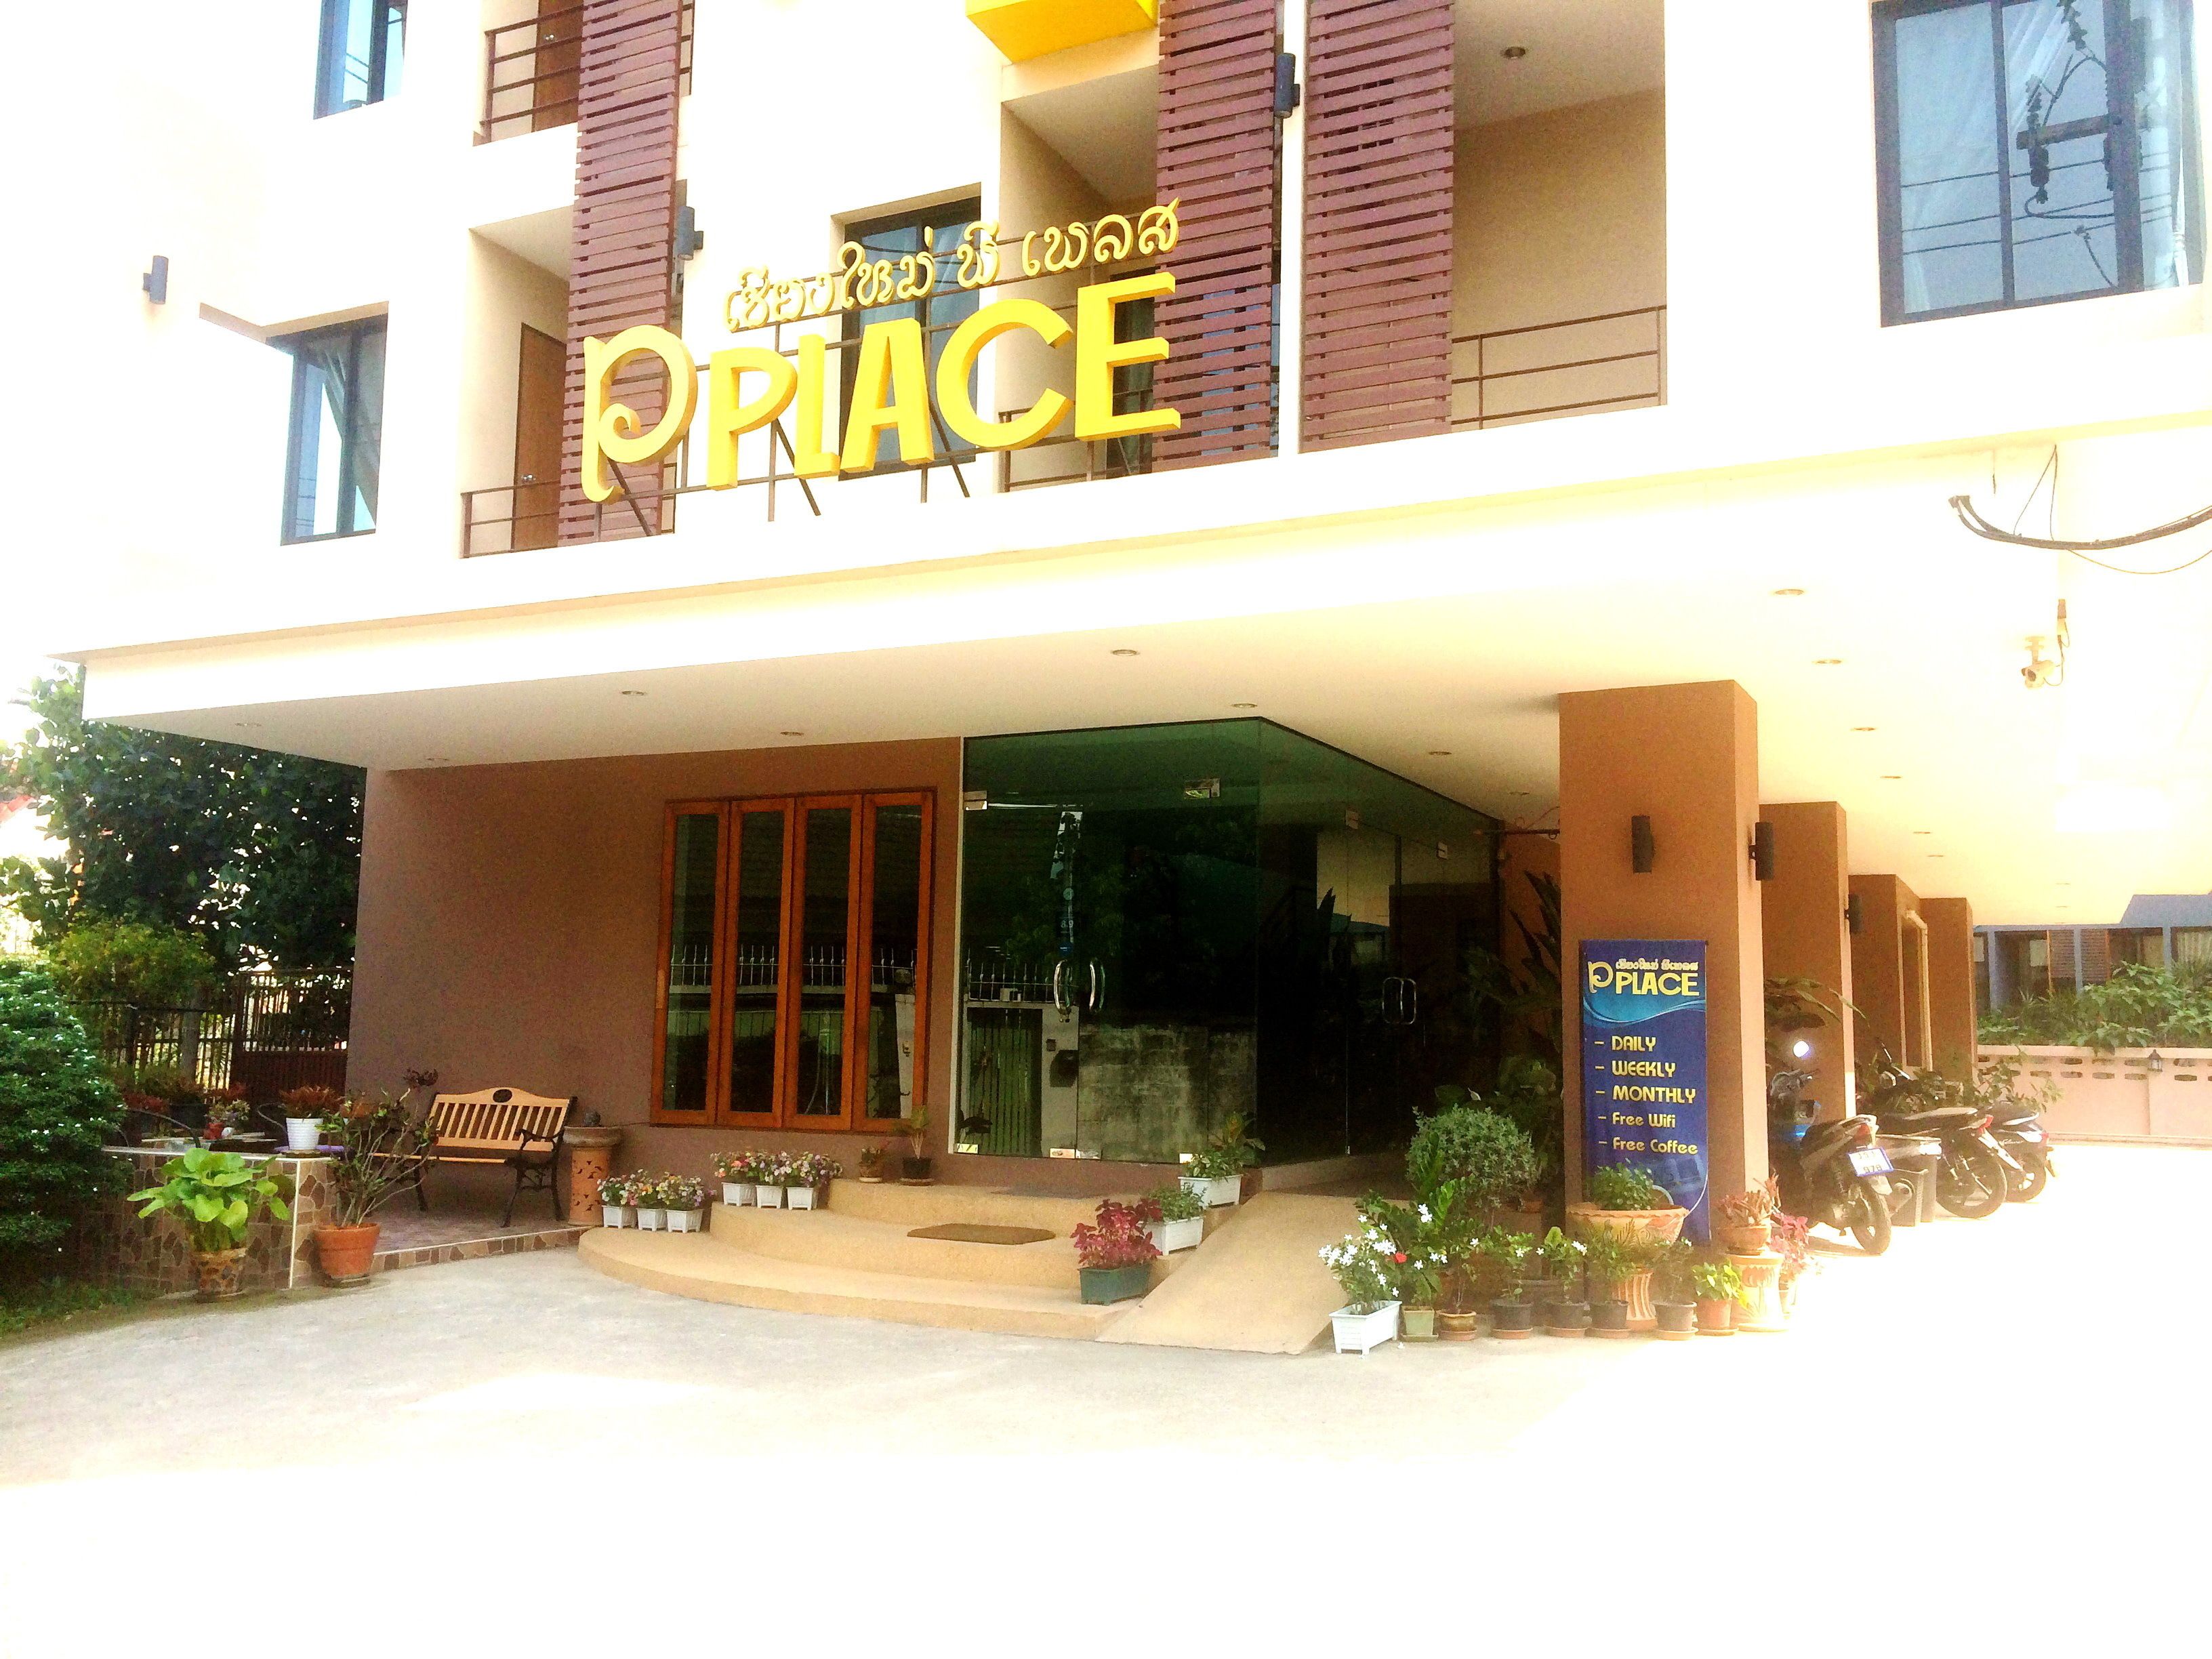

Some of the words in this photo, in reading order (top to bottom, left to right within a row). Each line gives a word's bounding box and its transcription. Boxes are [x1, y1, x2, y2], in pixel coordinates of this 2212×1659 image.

[724, 226, 935, 333] เชียงใหม่
[1022, 197, 1180, 276] เพลส
[1616, 971, 1700, 996] PLACE
[1612, 1036, 1656, 1051] DAILY
[1612, 1061, 1675, 1077] WEEKLY
[1613, 1085, 1696, 1103] MONTHLY
[1612, 1112, 1644, 1126] Free
[1649, 1113, 1675, 1128] Wifi
[1613, 1137, 1645, 1151] Free
[1650, 1139, 1698, 1154] Coffee
